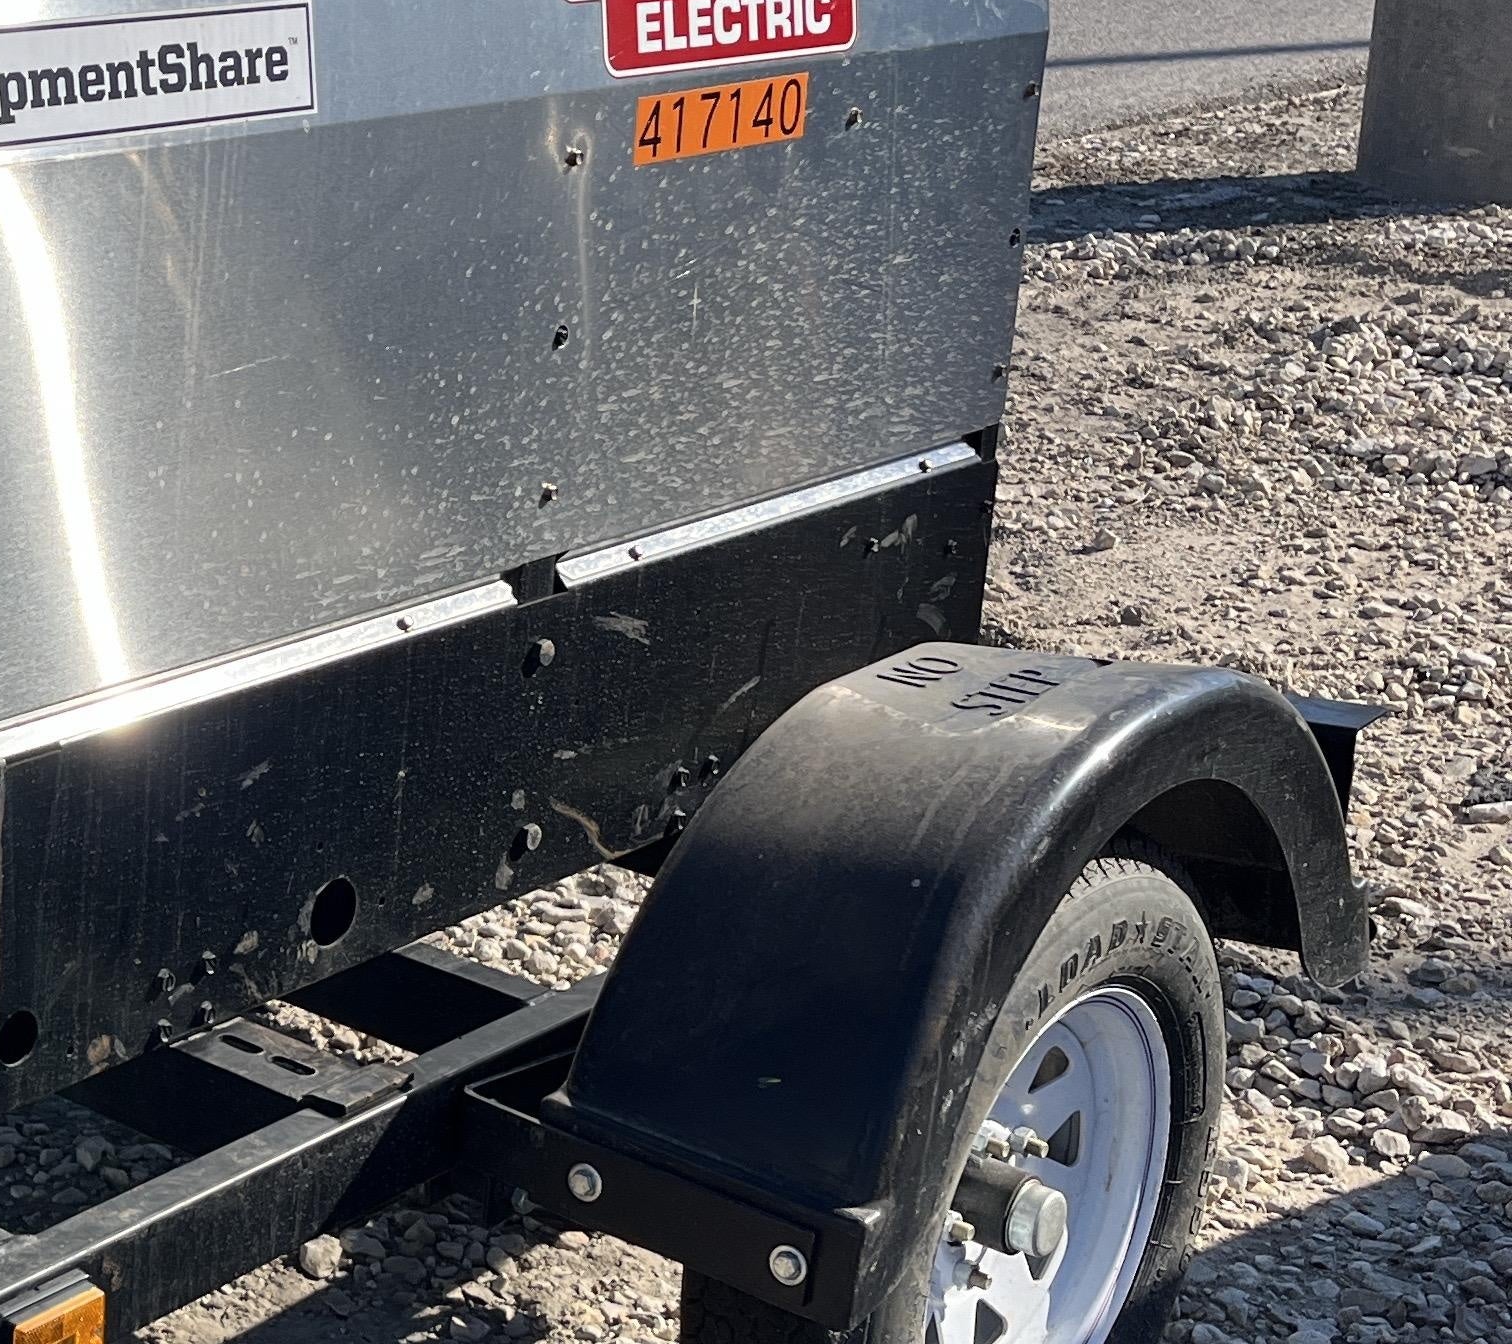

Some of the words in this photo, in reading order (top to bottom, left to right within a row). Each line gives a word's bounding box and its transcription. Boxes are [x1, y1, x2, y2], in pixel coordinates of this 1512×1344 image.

[638, 78, 801, 157] 417140
[876, 657, 964, 688] NO
[951, 669, 1060, 716] STEP
